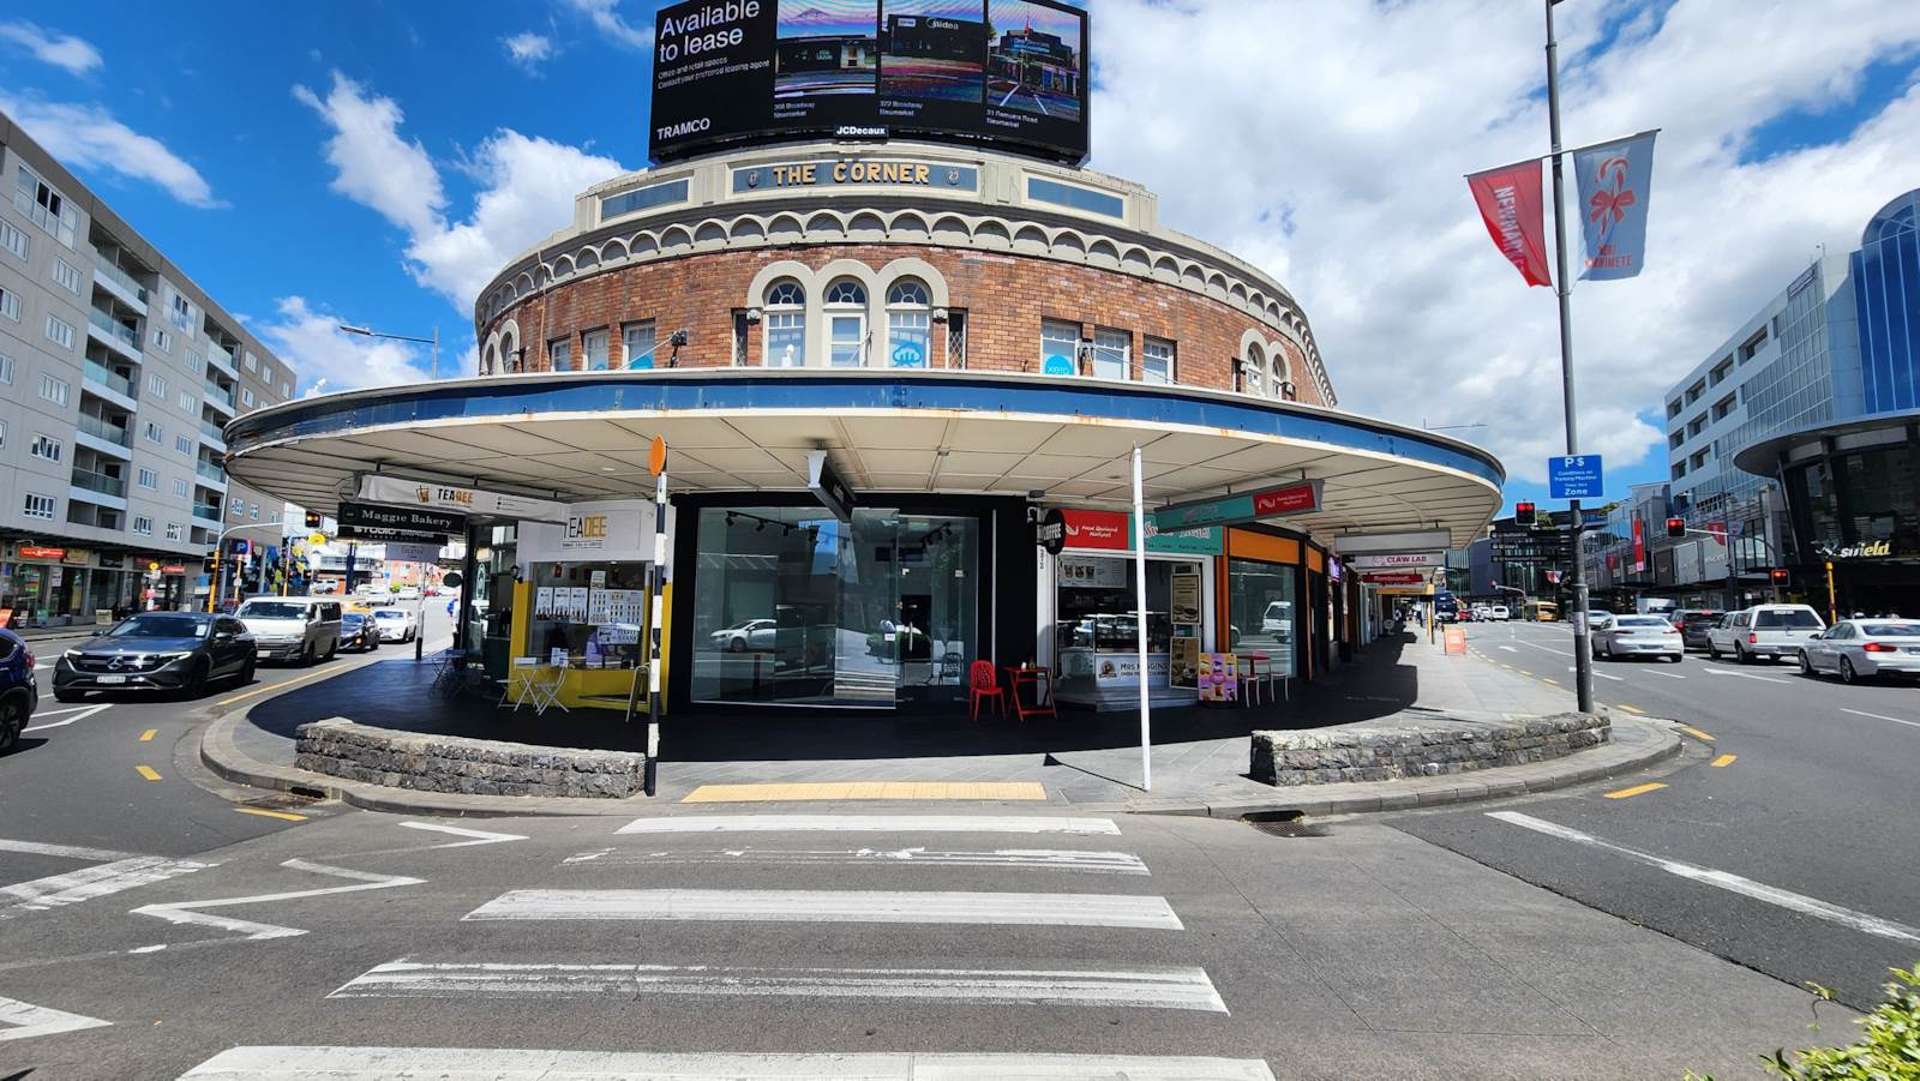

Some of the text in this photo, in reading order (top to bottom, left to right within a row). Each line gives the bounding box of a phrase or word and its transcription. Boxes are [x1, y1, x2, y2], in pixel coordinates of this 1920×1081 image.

[660, 0, 760, 40] Available
[660, 28, 743, 63] to lease
[656, 117, 711, 140] TRAMCO
[836, 126, 886, 137] JCDecaux
[773, 160, 930, 187] THE CORNER
[437, 488, 474, 504] TEADEE
[1564, 487, 1588, 496] Zone
[362, 508, 452, 528] Maggie Bakery
